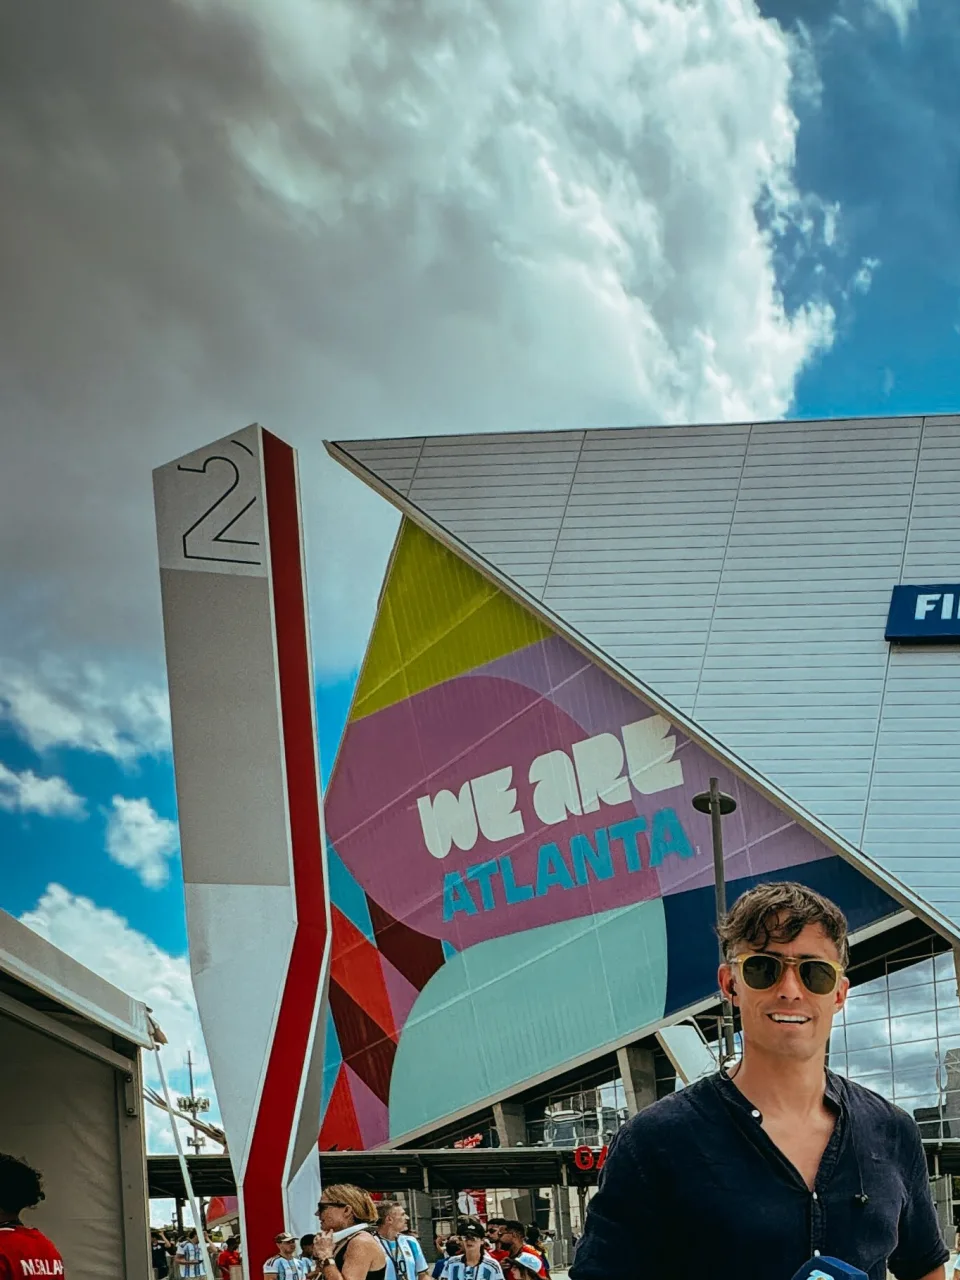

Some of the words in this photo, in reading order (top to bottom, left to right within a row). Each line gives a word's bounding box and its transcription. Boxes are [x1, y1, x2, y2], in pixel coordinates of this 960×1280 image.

[177, 439, 262, 566] 2
[416, 765, 525, 859] WE
[528, 713, 685, 826] ARE
[442, 806, 695, 923] ATLANTA
